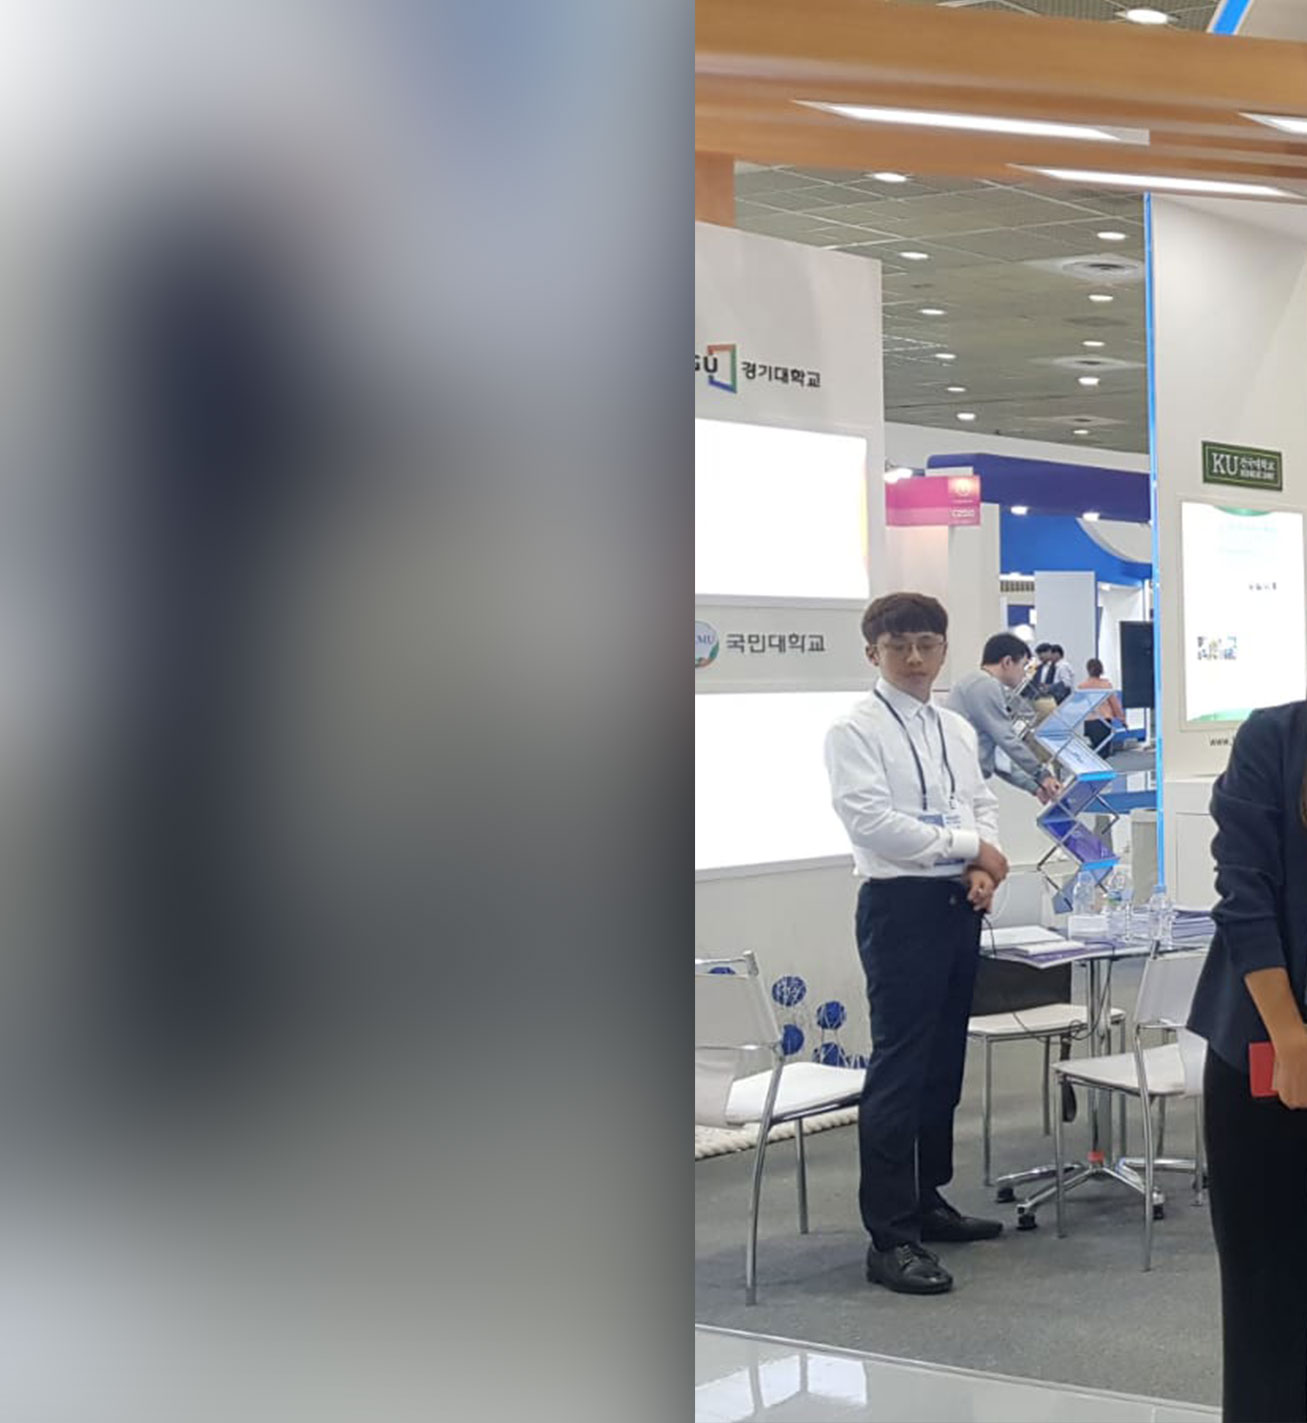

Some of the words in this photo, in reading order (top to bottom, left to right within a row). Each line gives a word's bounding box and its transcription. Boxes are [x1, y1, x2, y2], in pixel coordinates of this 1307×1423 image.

[741, 361, 821, 388] 경기대학교
[1211, 453, 1239, 476] KU
[726, 632, 825, 654] 국민대학교
